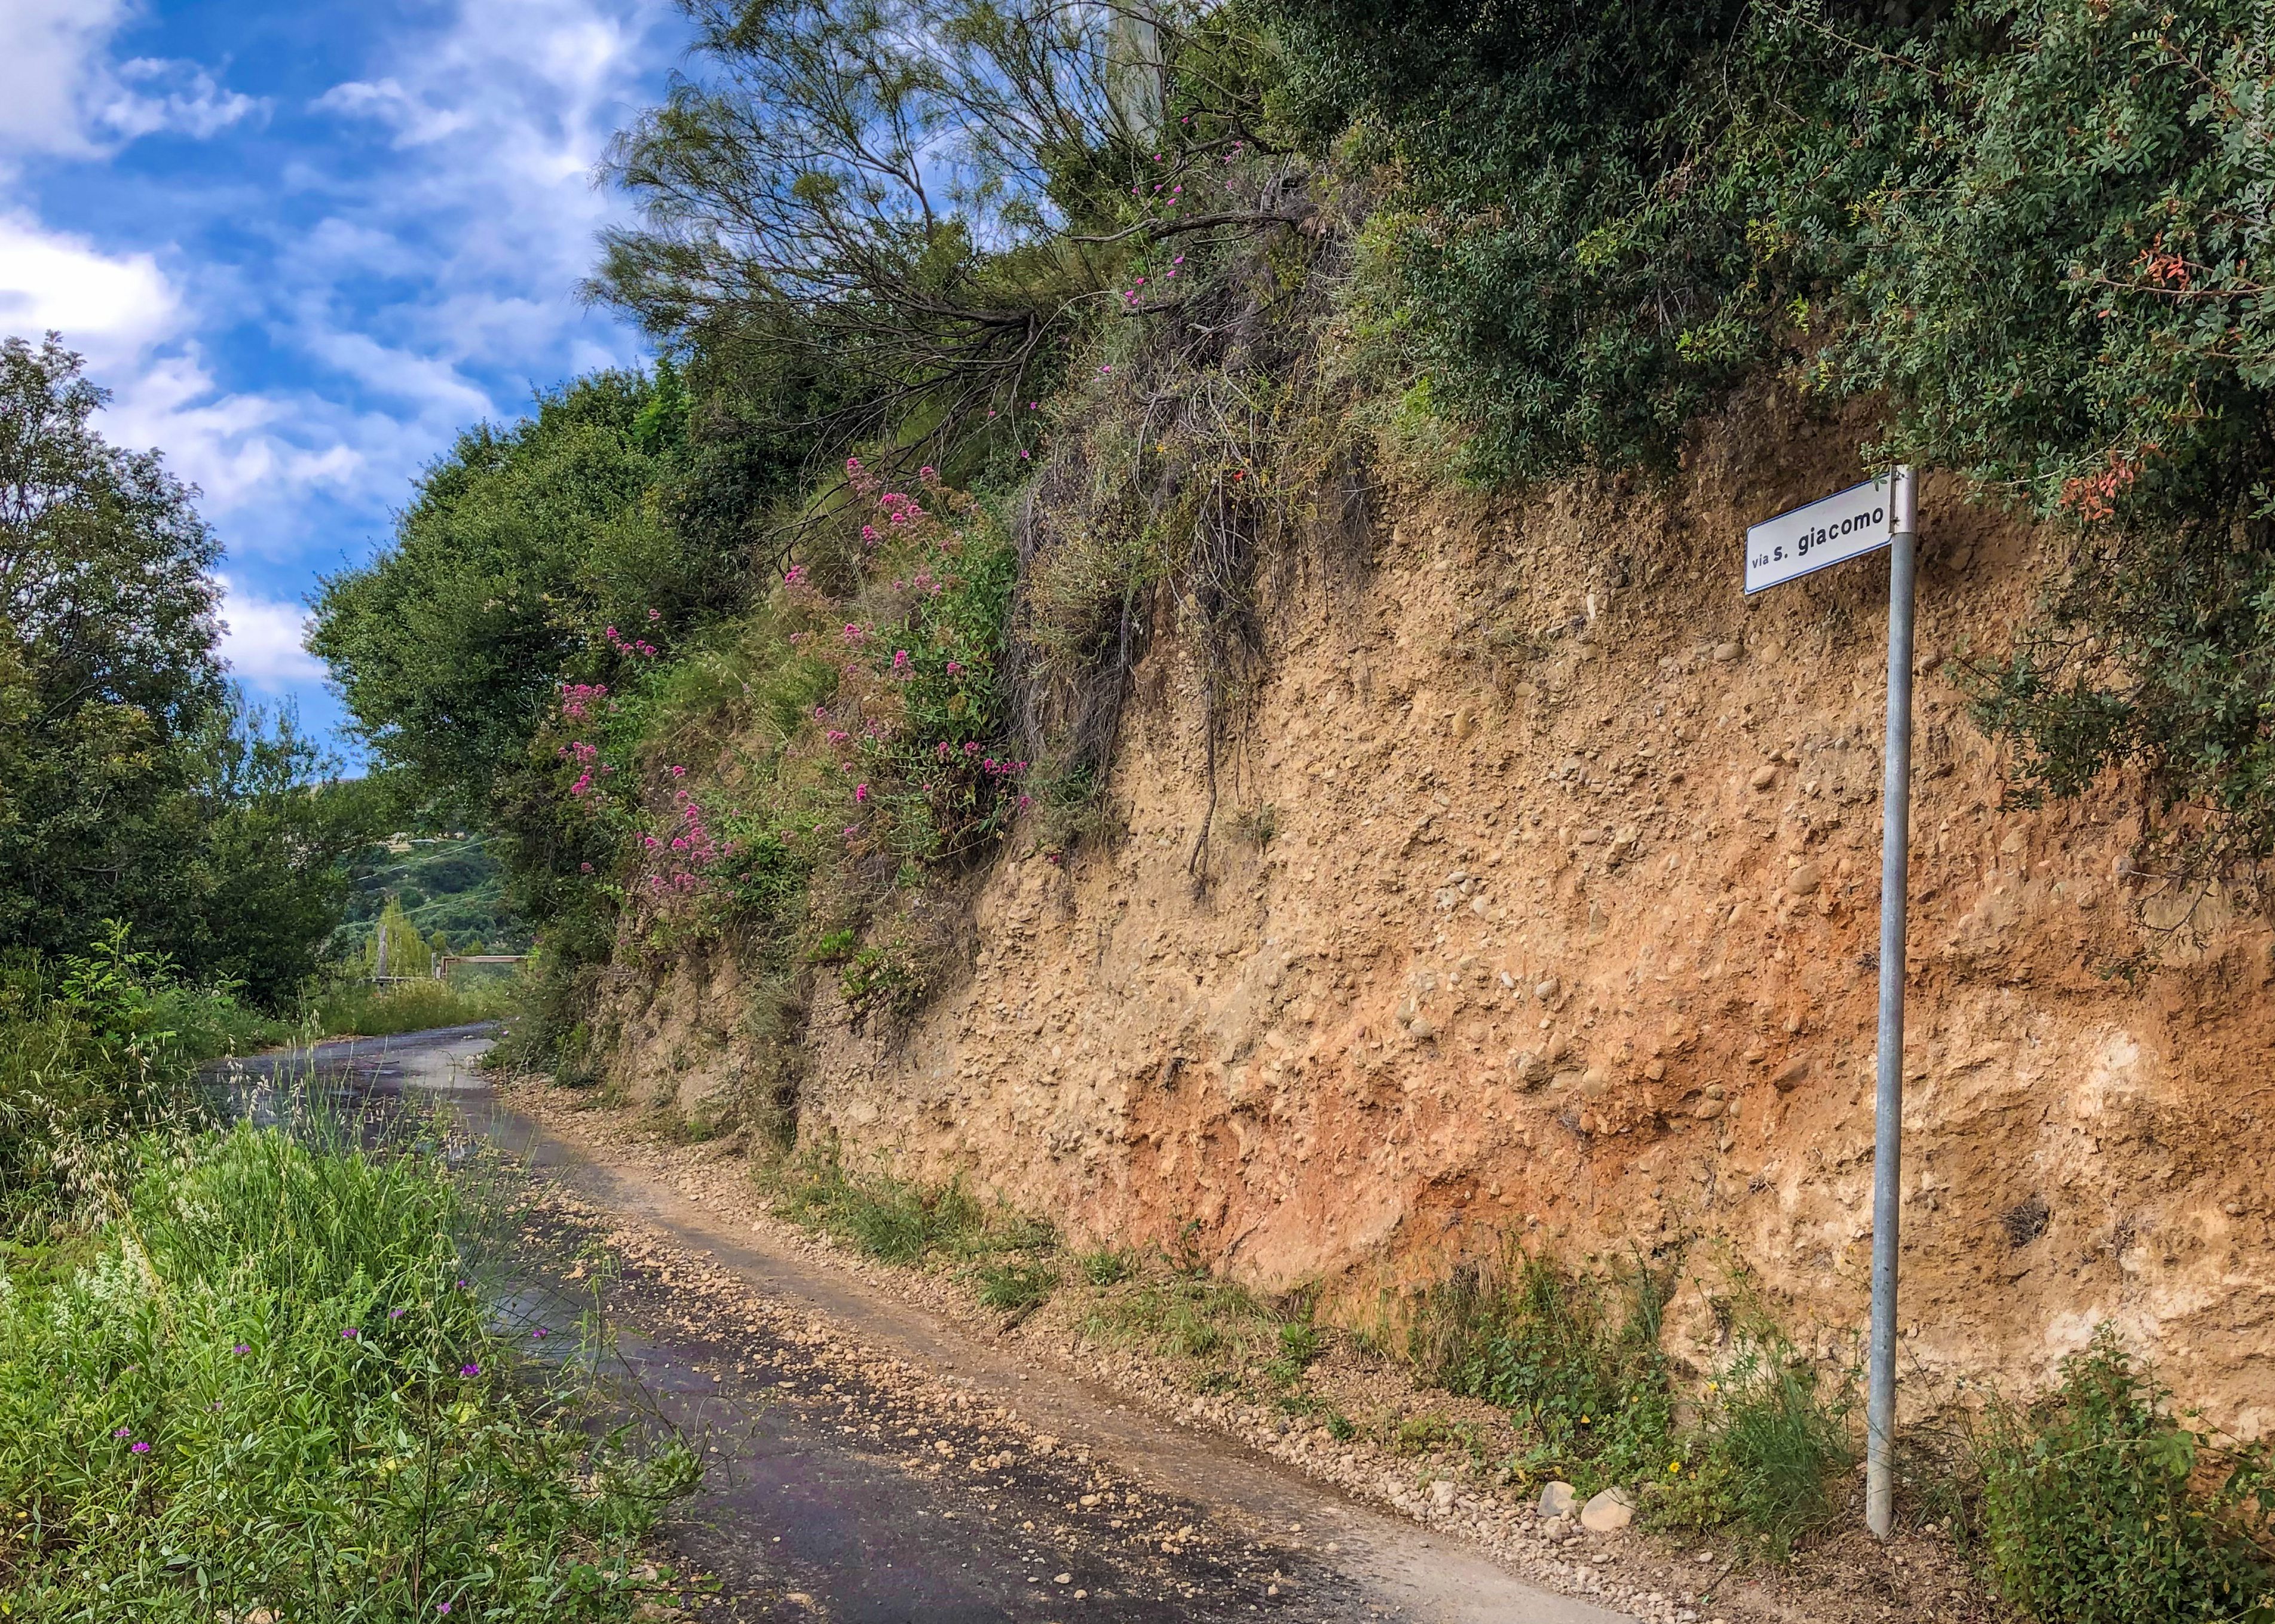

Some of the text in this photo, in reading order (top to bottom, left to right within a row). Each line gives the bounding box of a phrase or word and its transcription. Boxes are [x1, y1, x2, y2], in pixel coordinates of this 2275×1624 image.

[1752, 507, 1884, 568] via s. giacomo
